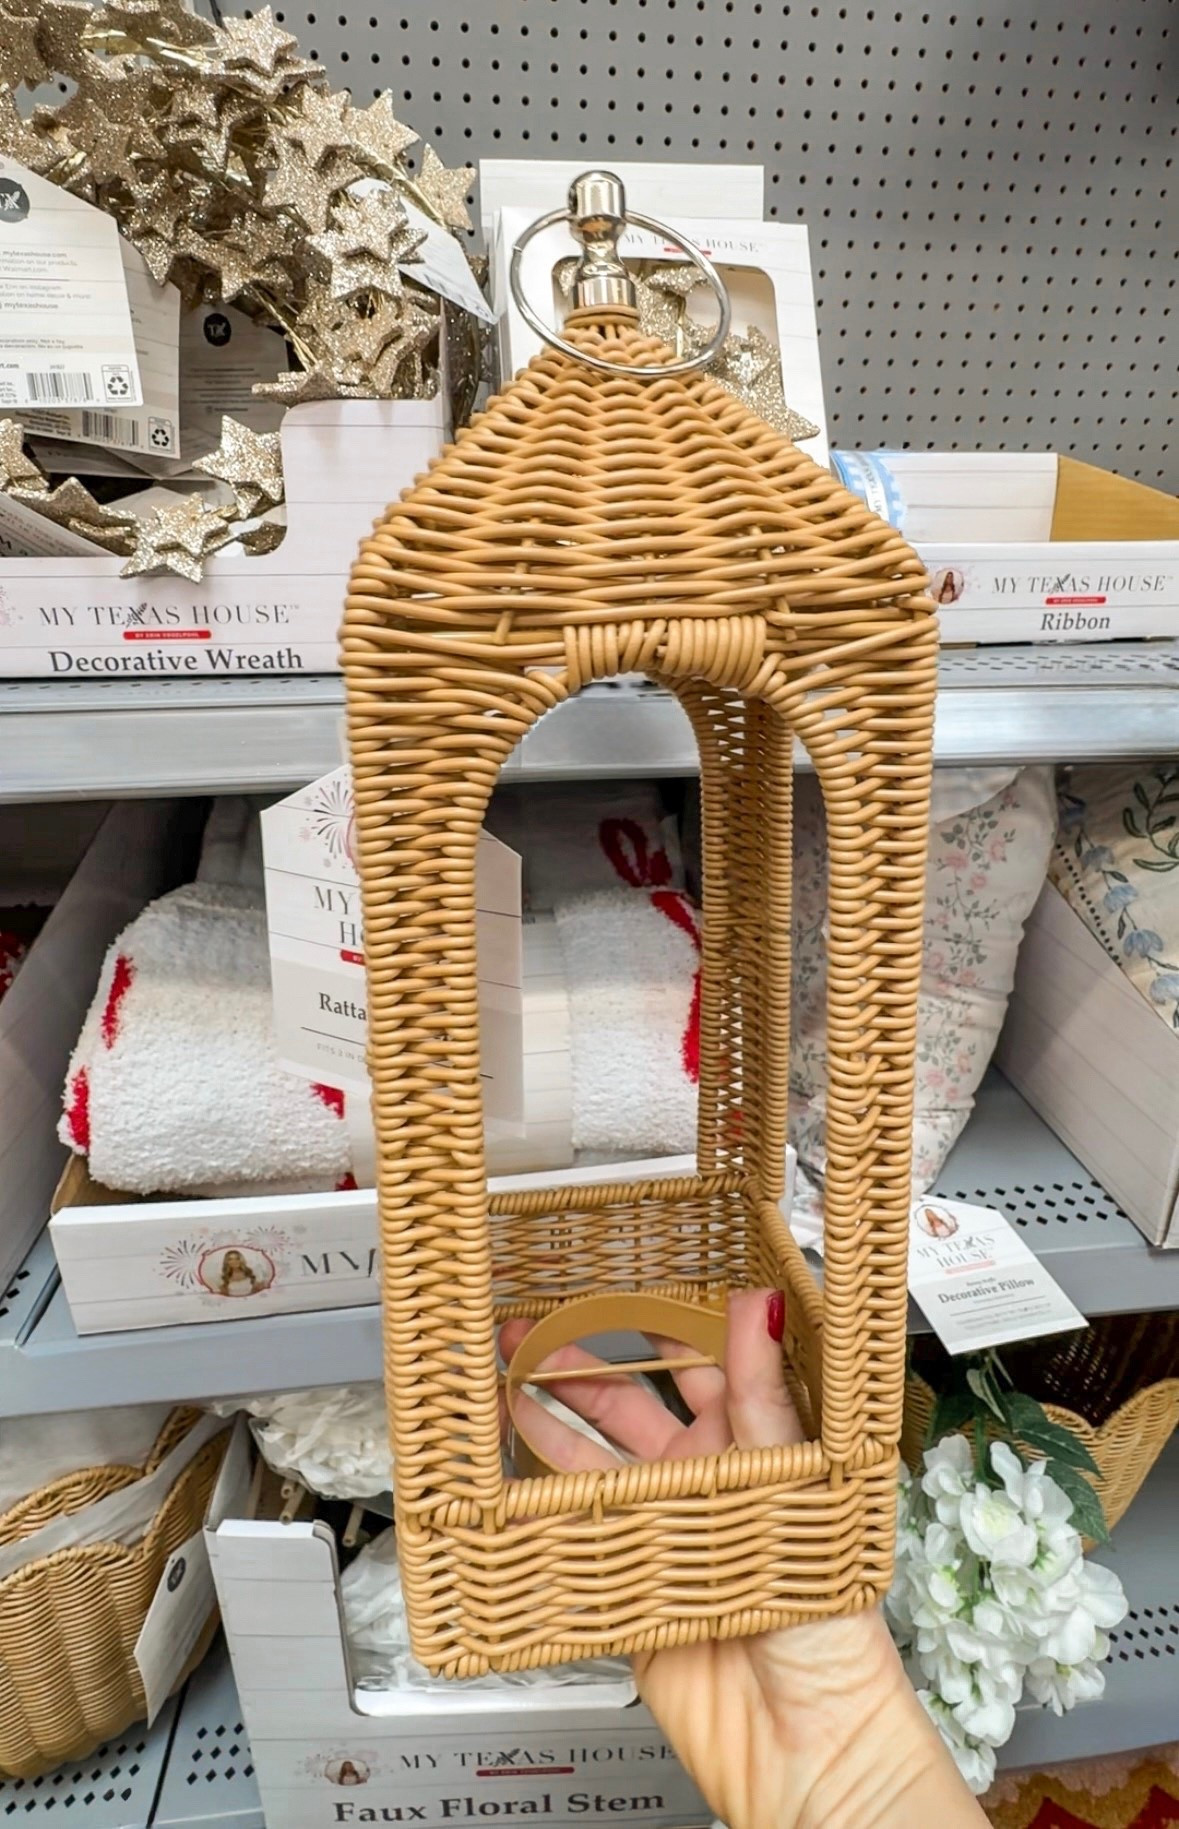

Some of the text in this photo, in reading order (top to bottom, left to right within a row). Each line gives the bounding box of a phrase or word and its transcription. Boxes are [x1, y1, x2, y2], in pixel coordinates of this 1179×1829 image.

[991, 576, 1020, 594] MY
[1027, 573, 1090, 594] TEXAS
[39, 606, 76, 626] MY
[87, 602, 181, 628] TEXAS
[1040, 612, 1111, 631] Ribbon
[48, 648, 304, 672] Decorative Wreath
[313, 885, 354, 916] MY
[318, 992, 368, 1022] Ratta
[938, 1286, 998, 1304] Decorative
[998, 1278, 1035, 1292] Pillow
[400, 1753, 440, 1769] MY
[453, 1748, 556, 1768] TEXAS
[332, 1792, 665, 1823] Faux Floral Stem
